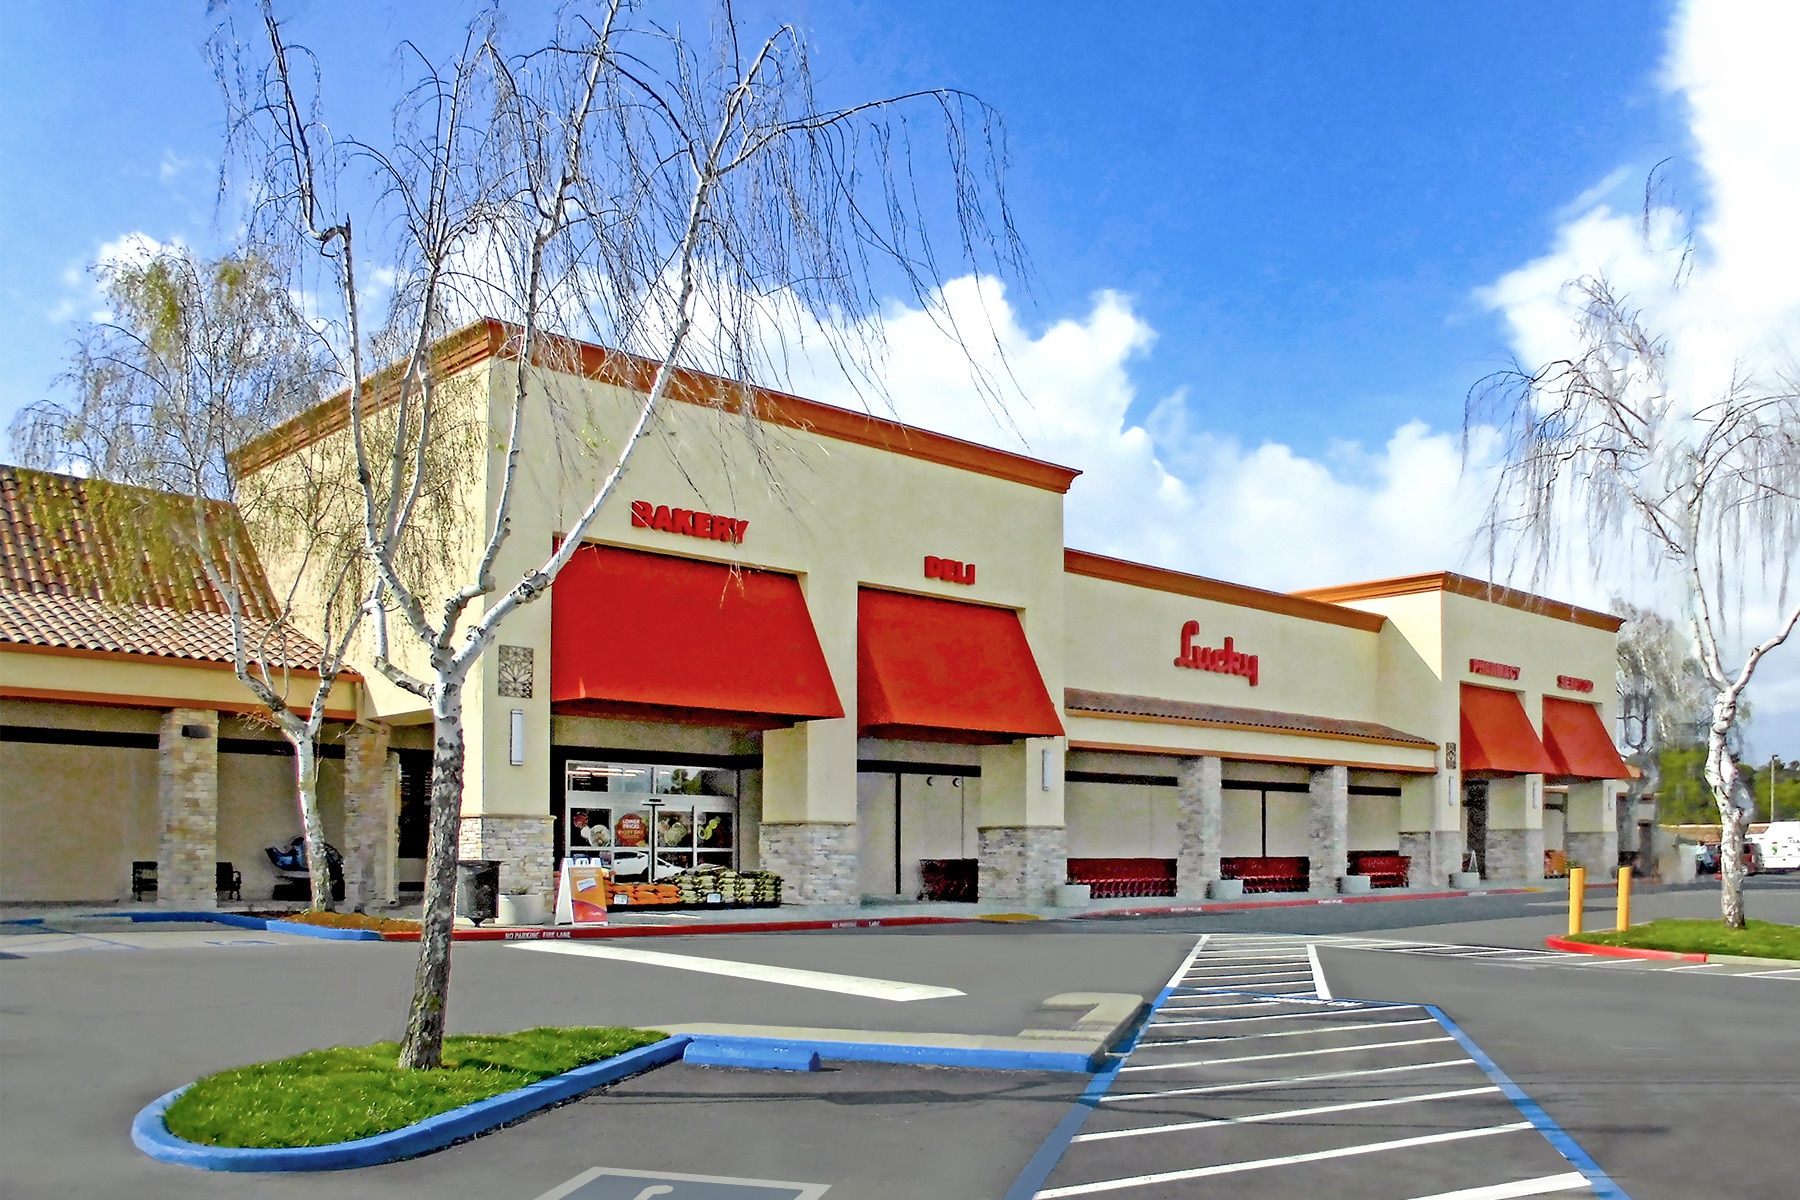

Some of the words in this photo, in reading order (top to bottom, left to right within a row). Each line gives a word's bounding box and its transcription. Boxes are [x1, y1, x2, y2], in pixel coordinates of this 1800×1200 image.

[631, 500, 749, 545] BAKERY
[924, 555, 975, 586] DELI
[1174, 620, 1259, 687] Lucky
